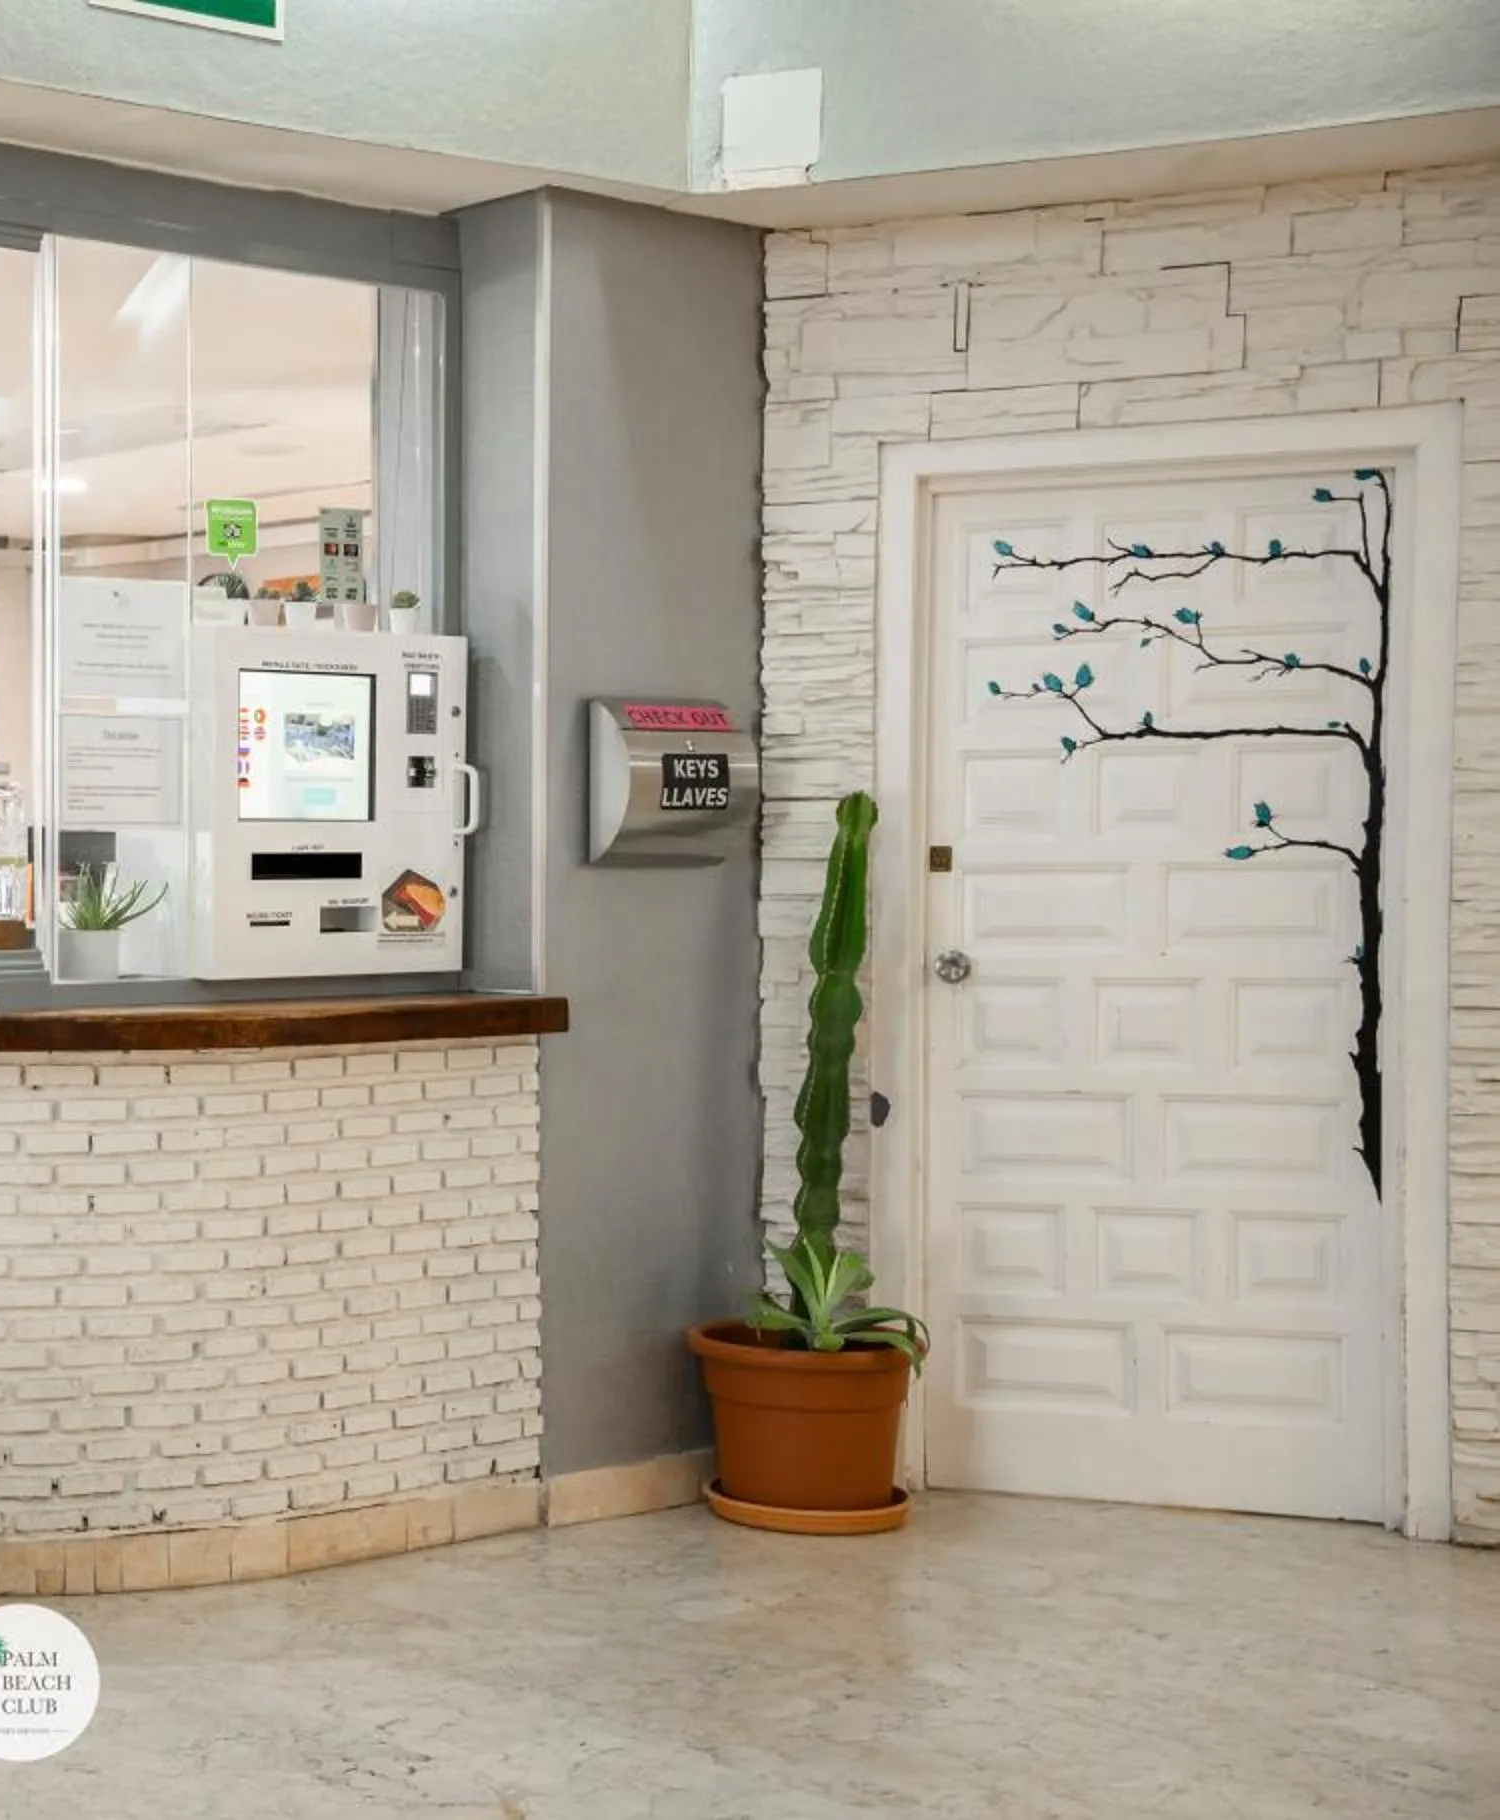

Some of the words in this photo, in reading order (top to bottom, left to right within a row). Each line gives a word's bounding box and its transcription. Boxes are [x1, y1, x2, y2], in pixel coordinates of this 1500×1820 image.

[627, 710, 684, 725] CHECK
[691, 711, 727, 726] OUT
[673, 758, 719, 779] KEYS
[661, 786, 729, 807] LLAVES
